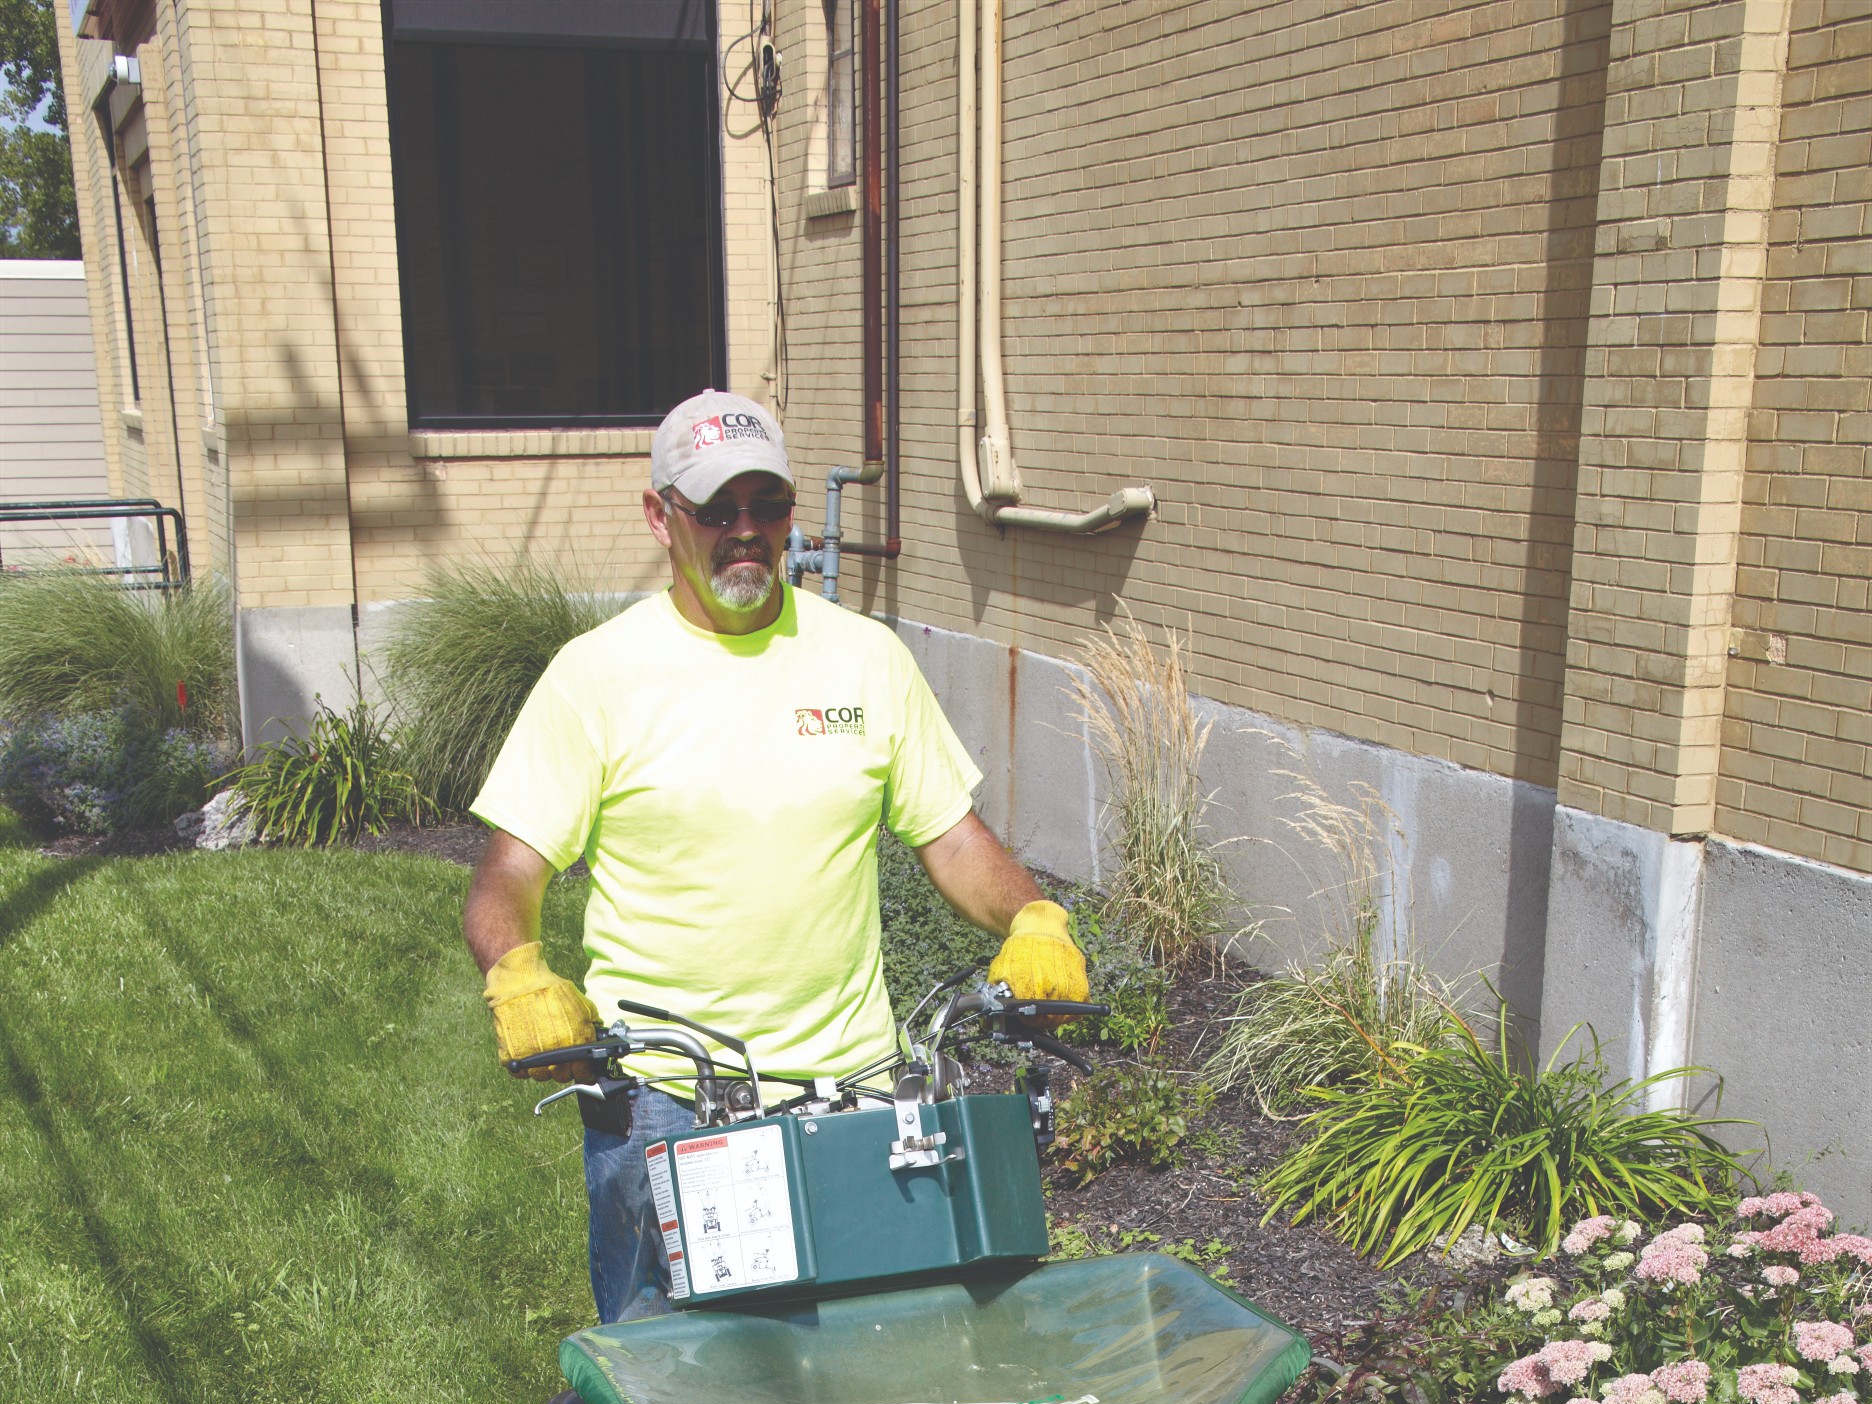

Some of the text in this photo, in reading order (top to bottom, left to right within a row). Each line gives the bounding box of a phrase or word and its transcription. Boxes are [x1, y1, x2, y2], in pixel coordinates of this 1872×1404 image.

[721, 413, 765, 432] COR
[825, 707, 864, 724] COR
[688, 1140, 723, 1150] WARNING
